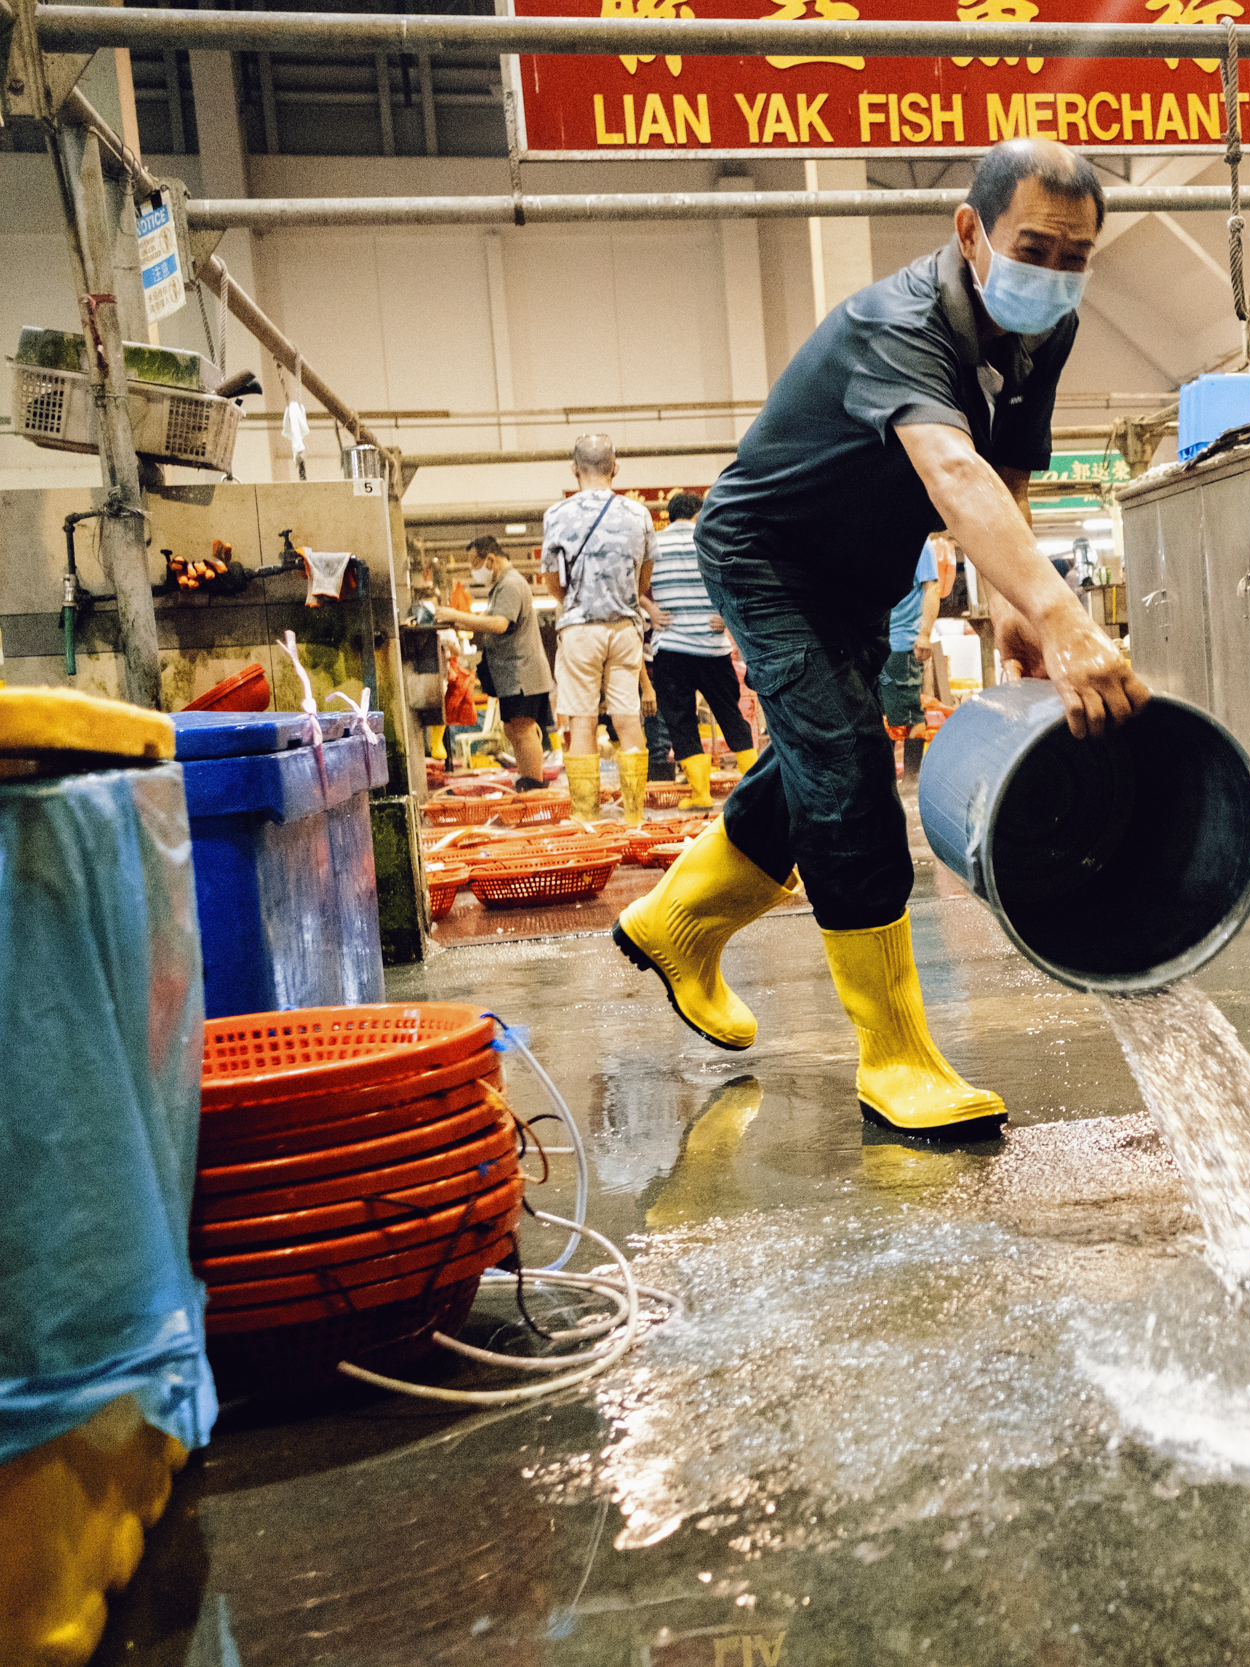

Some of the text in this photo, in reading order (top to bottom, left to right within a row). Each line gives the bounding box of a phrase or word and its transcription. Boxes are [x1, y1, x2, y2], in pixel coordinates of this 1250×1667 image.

[593, 92, 1250, 144] LIAN YAK FISH MERCHANT
[152, 261, 170, 283] 注意
[364, 482, 373, 493] 5
